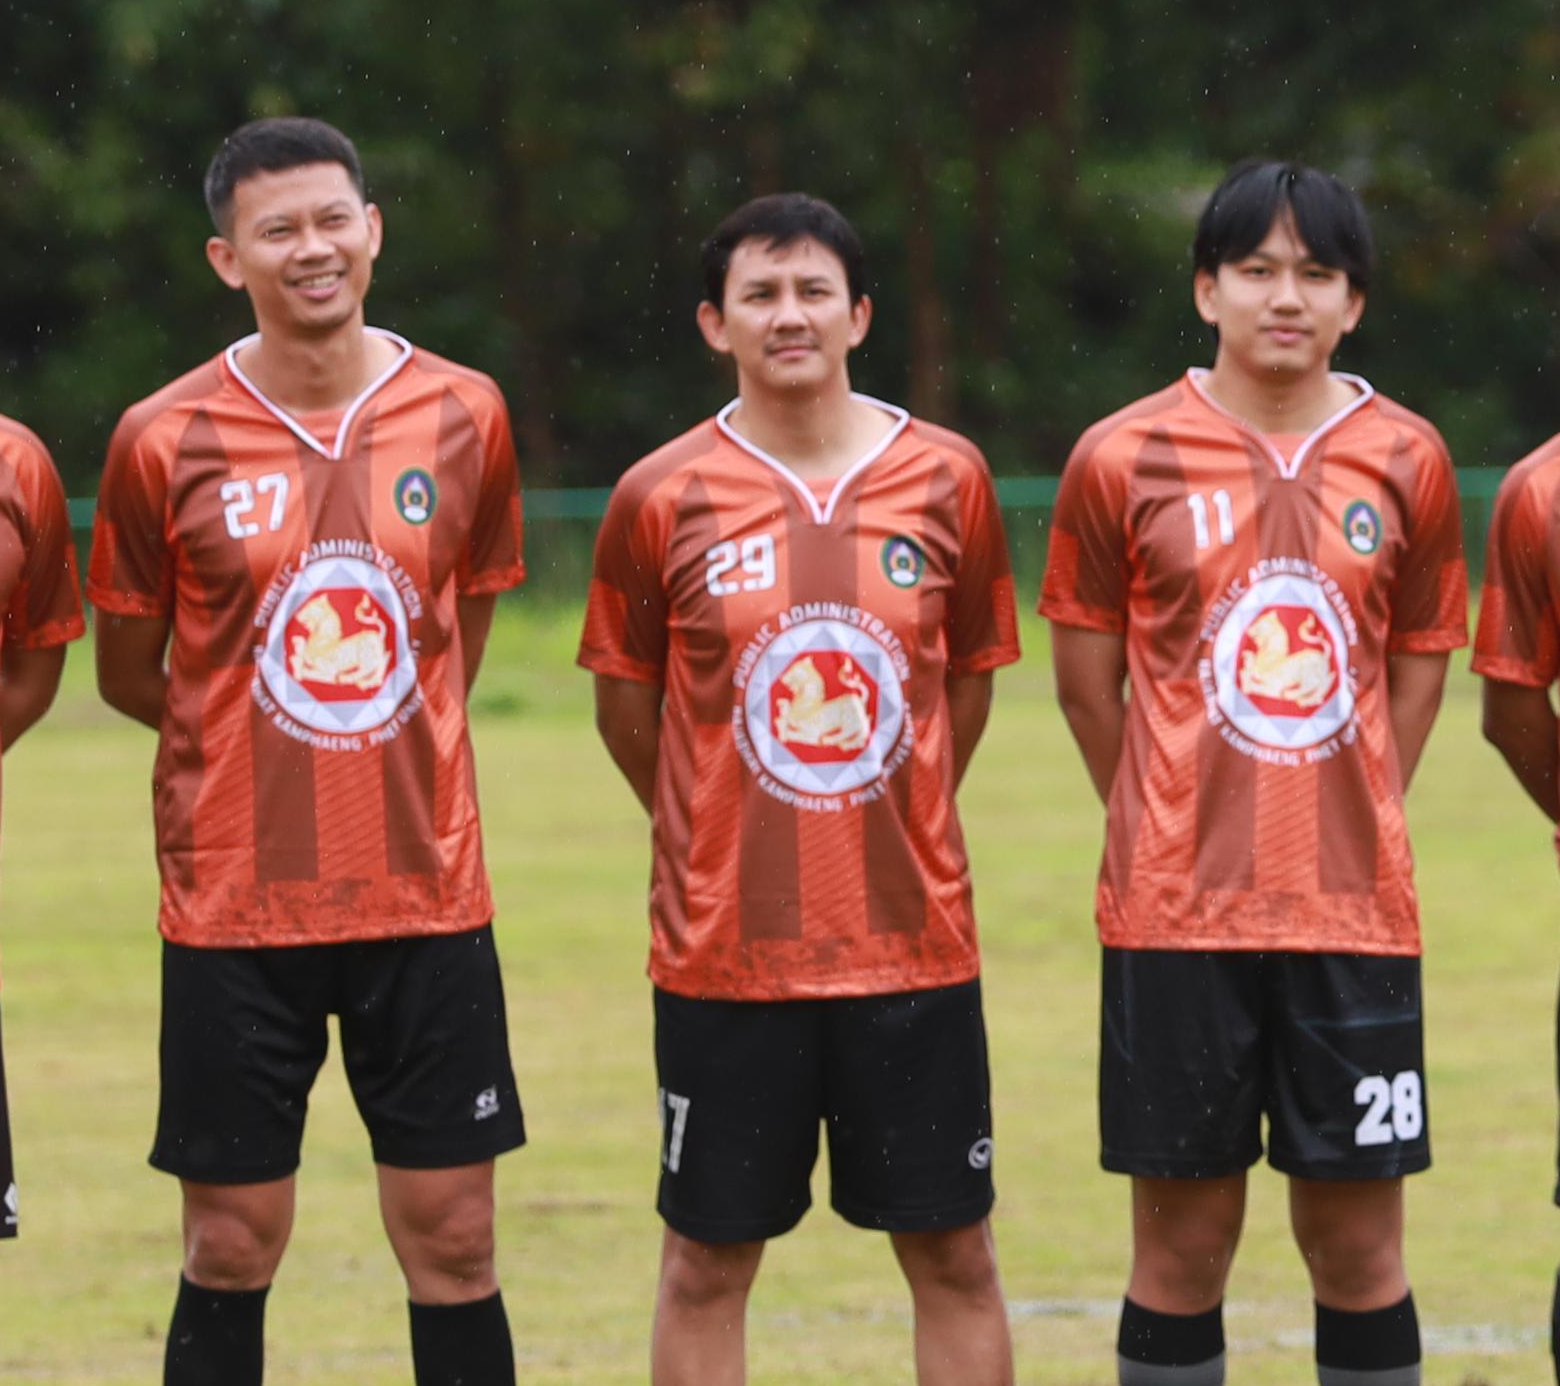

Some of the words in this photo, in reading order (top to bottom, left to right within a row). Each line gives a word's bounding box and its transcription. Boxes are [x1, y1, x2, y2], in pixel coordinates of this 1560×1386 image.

[219, 471, 290, 540] 27
[1186, 488, 1235, 550] 11
[704, 531, 777, 598] 29
[1354, 1069, 1423, 1147] 28
